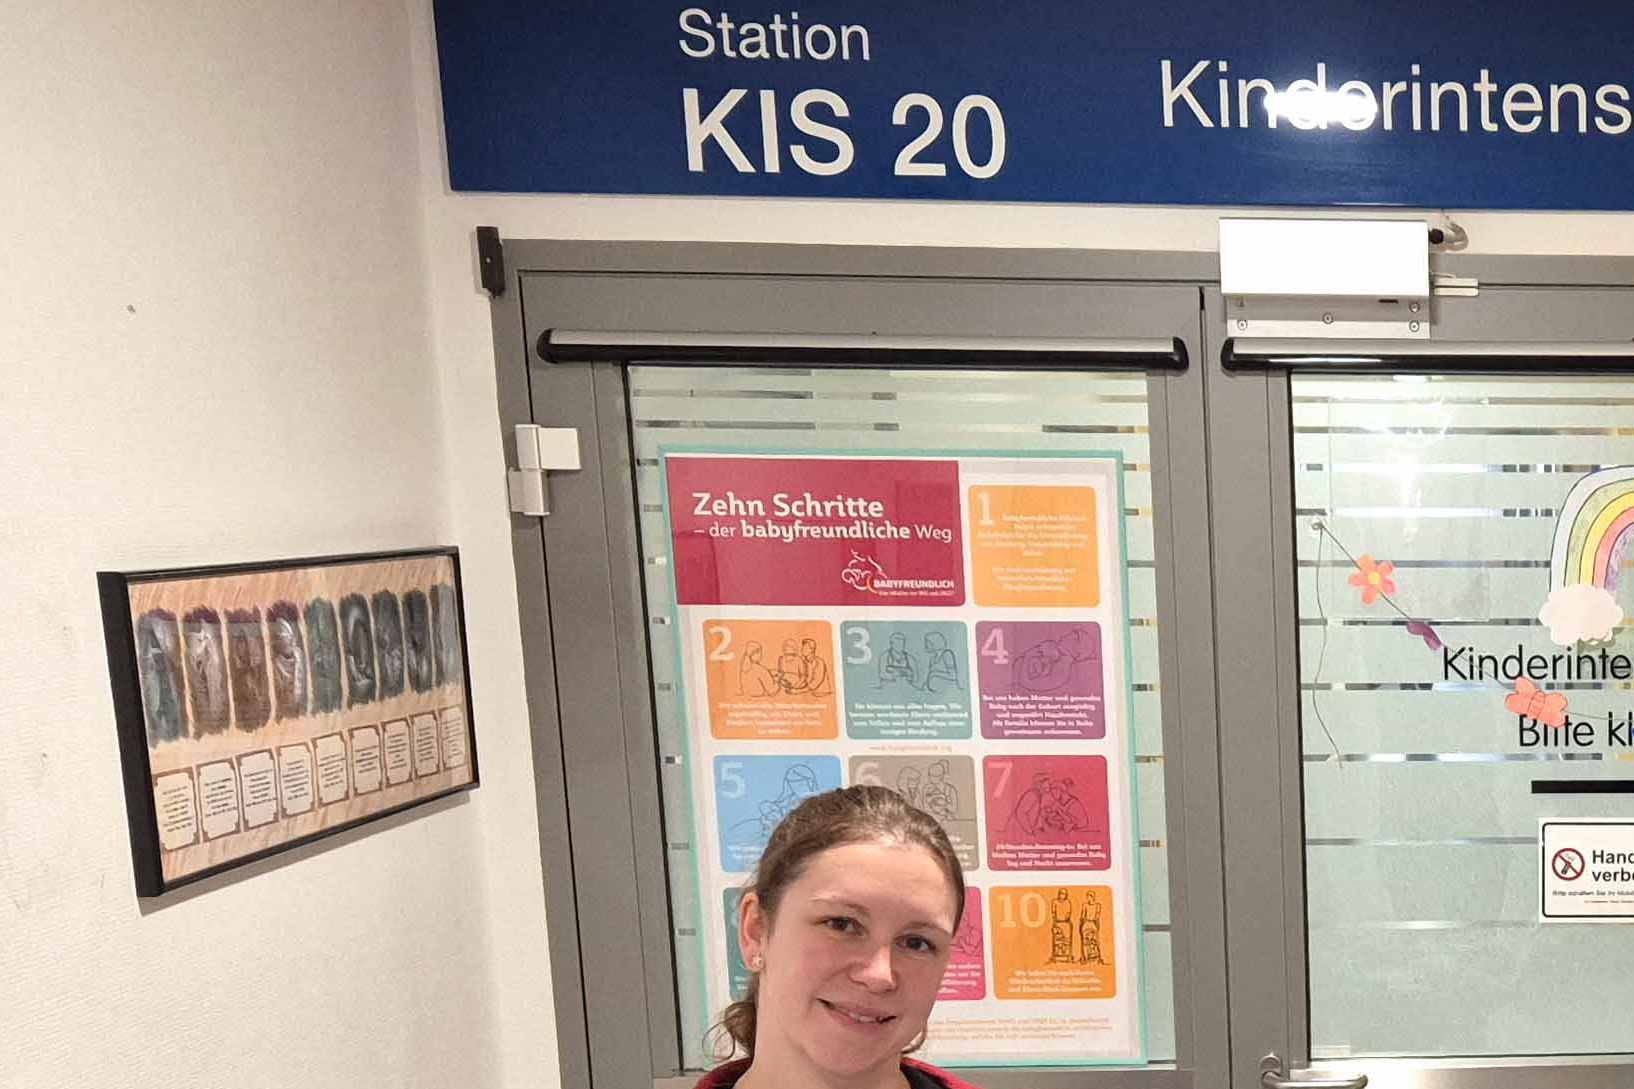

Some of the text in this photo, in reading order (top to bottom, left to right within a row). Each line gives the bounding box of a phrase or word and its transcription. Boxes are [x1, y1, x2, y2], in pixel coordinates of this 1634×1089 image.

[680, 8, 870, 61] Station
[682, 87, 1006, 179] KIS 20
[692, 491, 883, 517] Zehn Schritte
[977, 493, 995, 526] 1
[709, 522, 736, 538] der
[740, 520, 911, 542] babyfreundliche
[915, 524, 952, 544] Weg
[873, 579, 954, 589] BABYFREUNDLICH
[709, 629, 734, 663] 2
[847, 629, 872, 665] 3
[981, 629, 1008, 665] 4
[720, 763, 745, 799] 5
[987, 763, 1013, 798] 7
[998, 894, 1046, 929] 10
